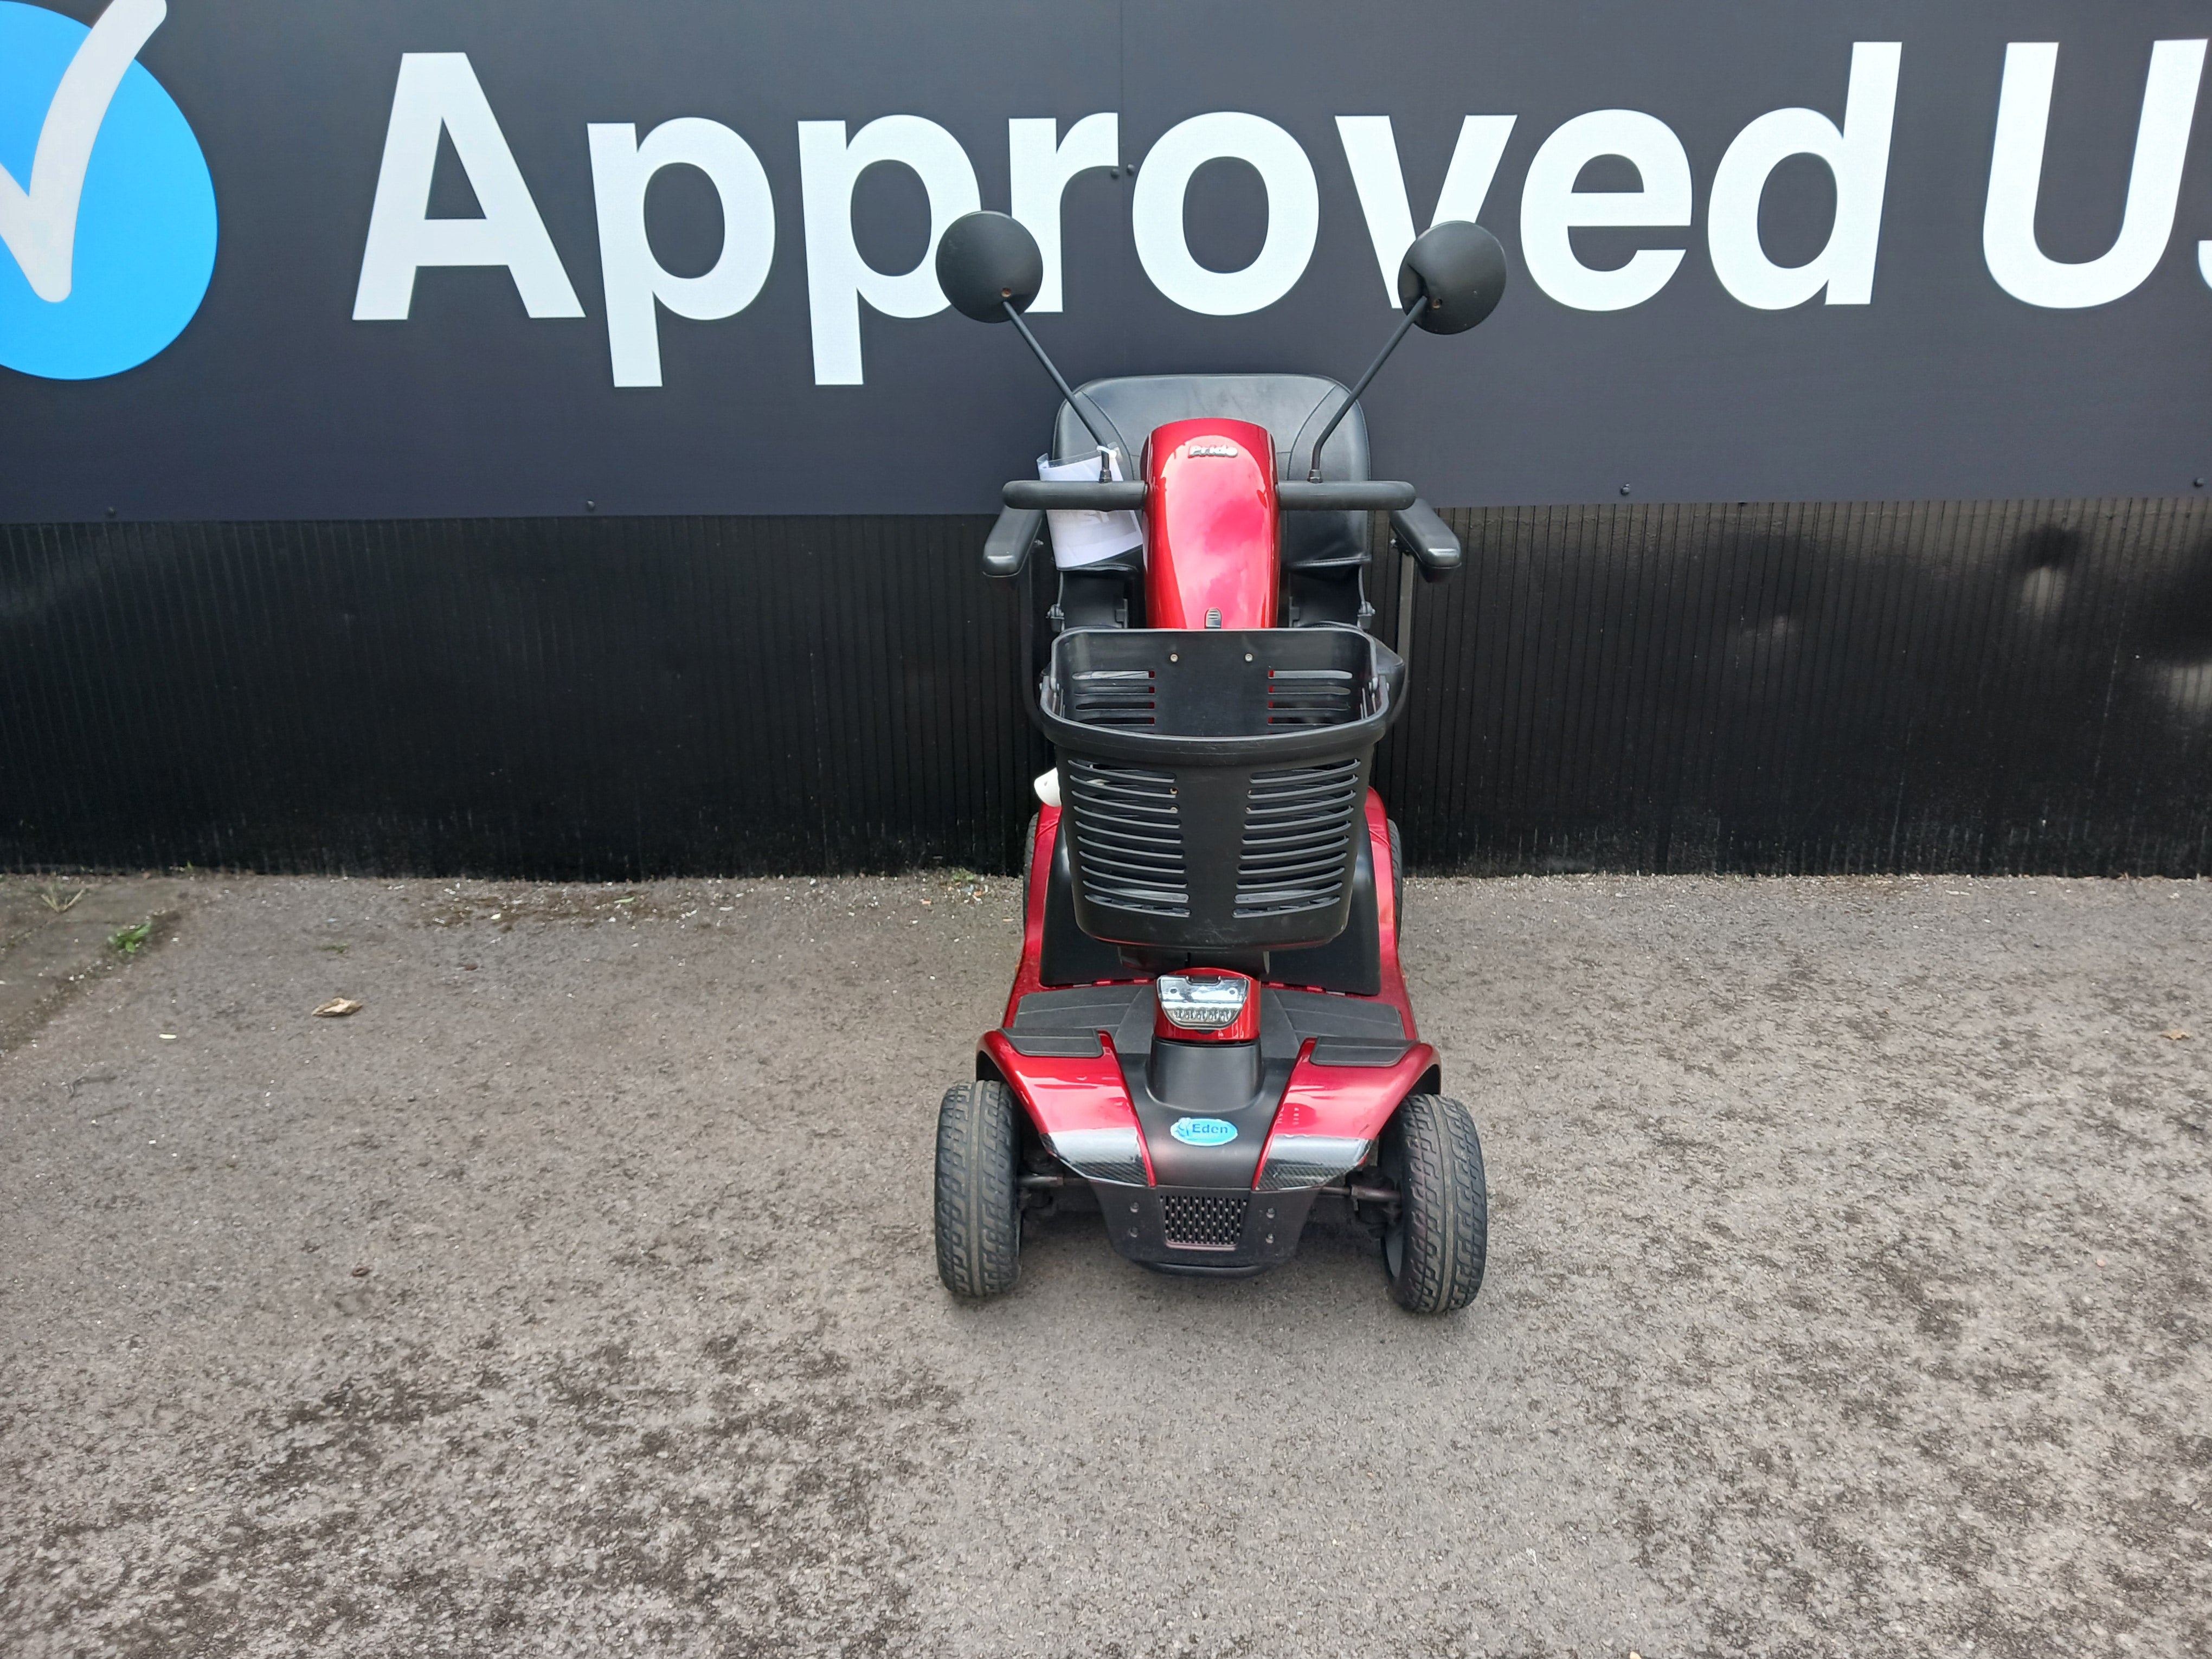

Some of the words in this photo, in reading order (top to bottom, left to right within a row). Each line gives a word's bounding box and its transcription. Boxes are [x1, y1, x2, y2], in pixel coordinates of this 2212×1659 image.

[352, 42, 1902, 387] Approved
[1983, 38, 2212, 309] U
[1189, 445, 1238, 458] Pride
[1192, 1124, 1228, 1133] Eden
